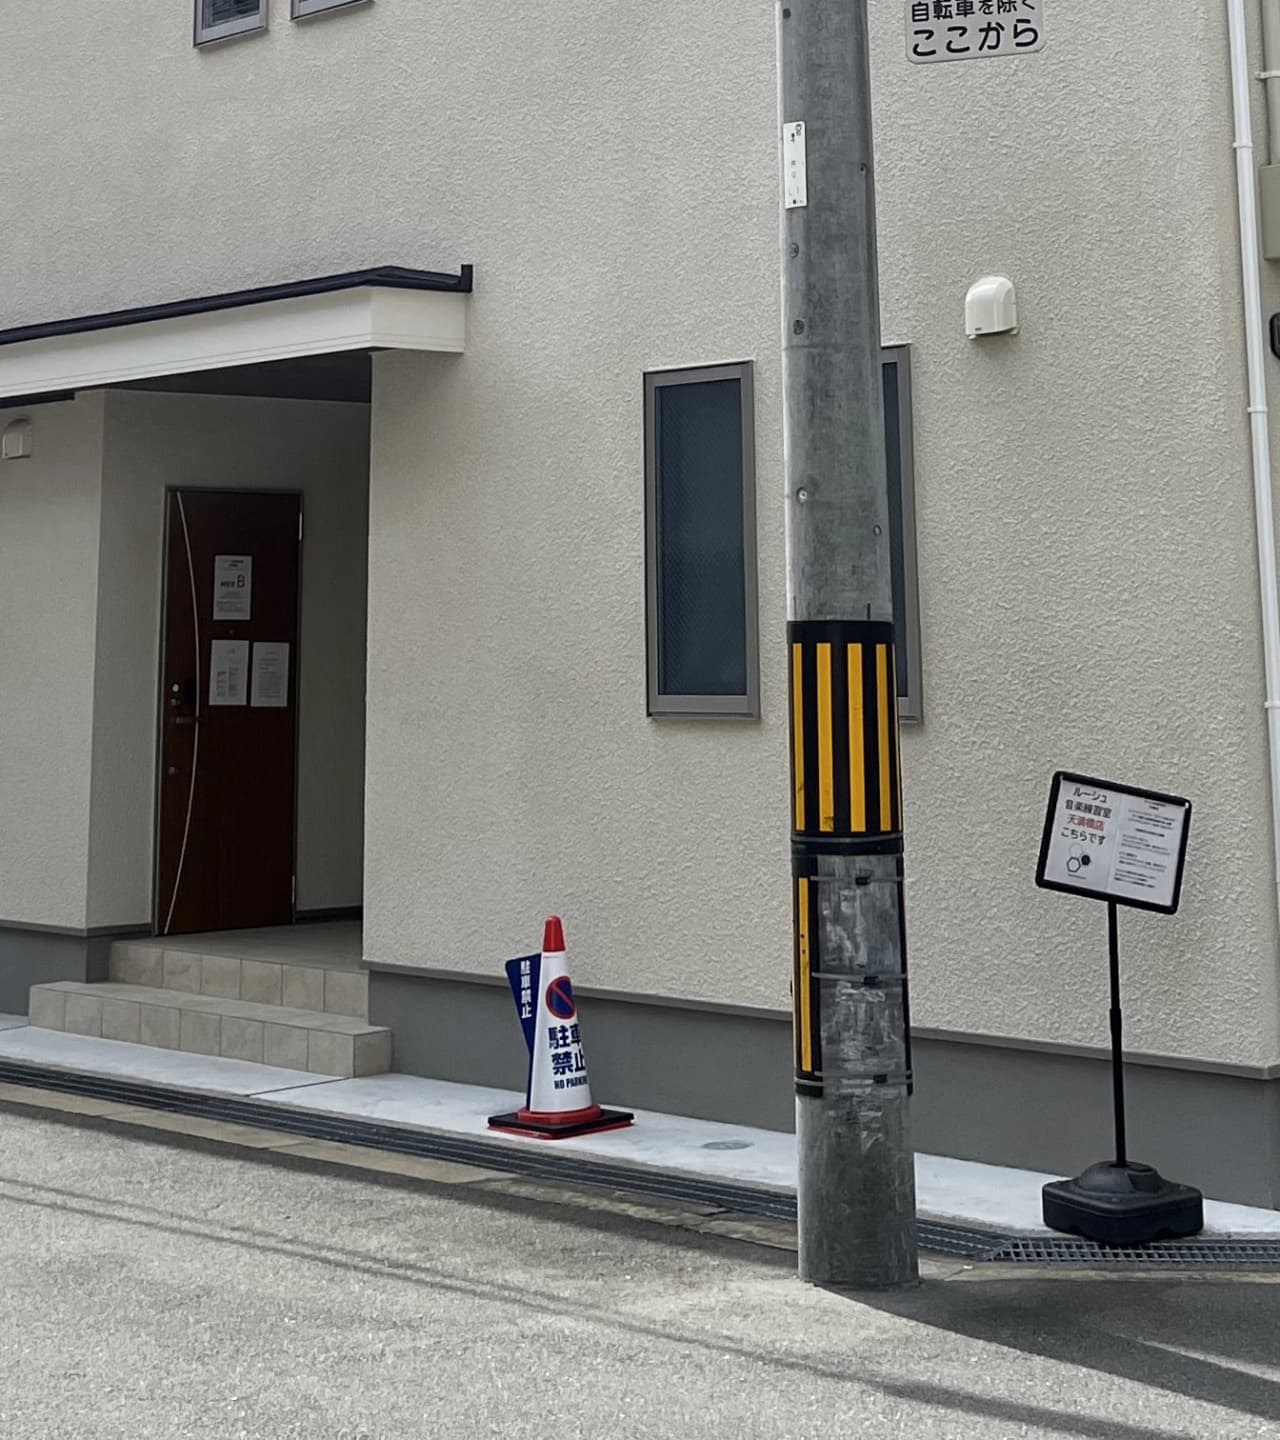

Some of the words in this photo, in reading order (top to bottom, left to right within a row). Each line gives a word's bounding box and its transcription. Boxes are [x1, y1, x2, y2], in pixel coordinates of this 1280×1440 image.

[912, 18, 1039, 58] ここから
[1072, 787, 1108, 803] ルーシュ
[1061, 826, 1107, 845] こちらです
[520, 960, 532, 1019] 駐車禁止
[551, 1050, 586, 1075] 禁止
[554, 1079, 565, 1090] NO
